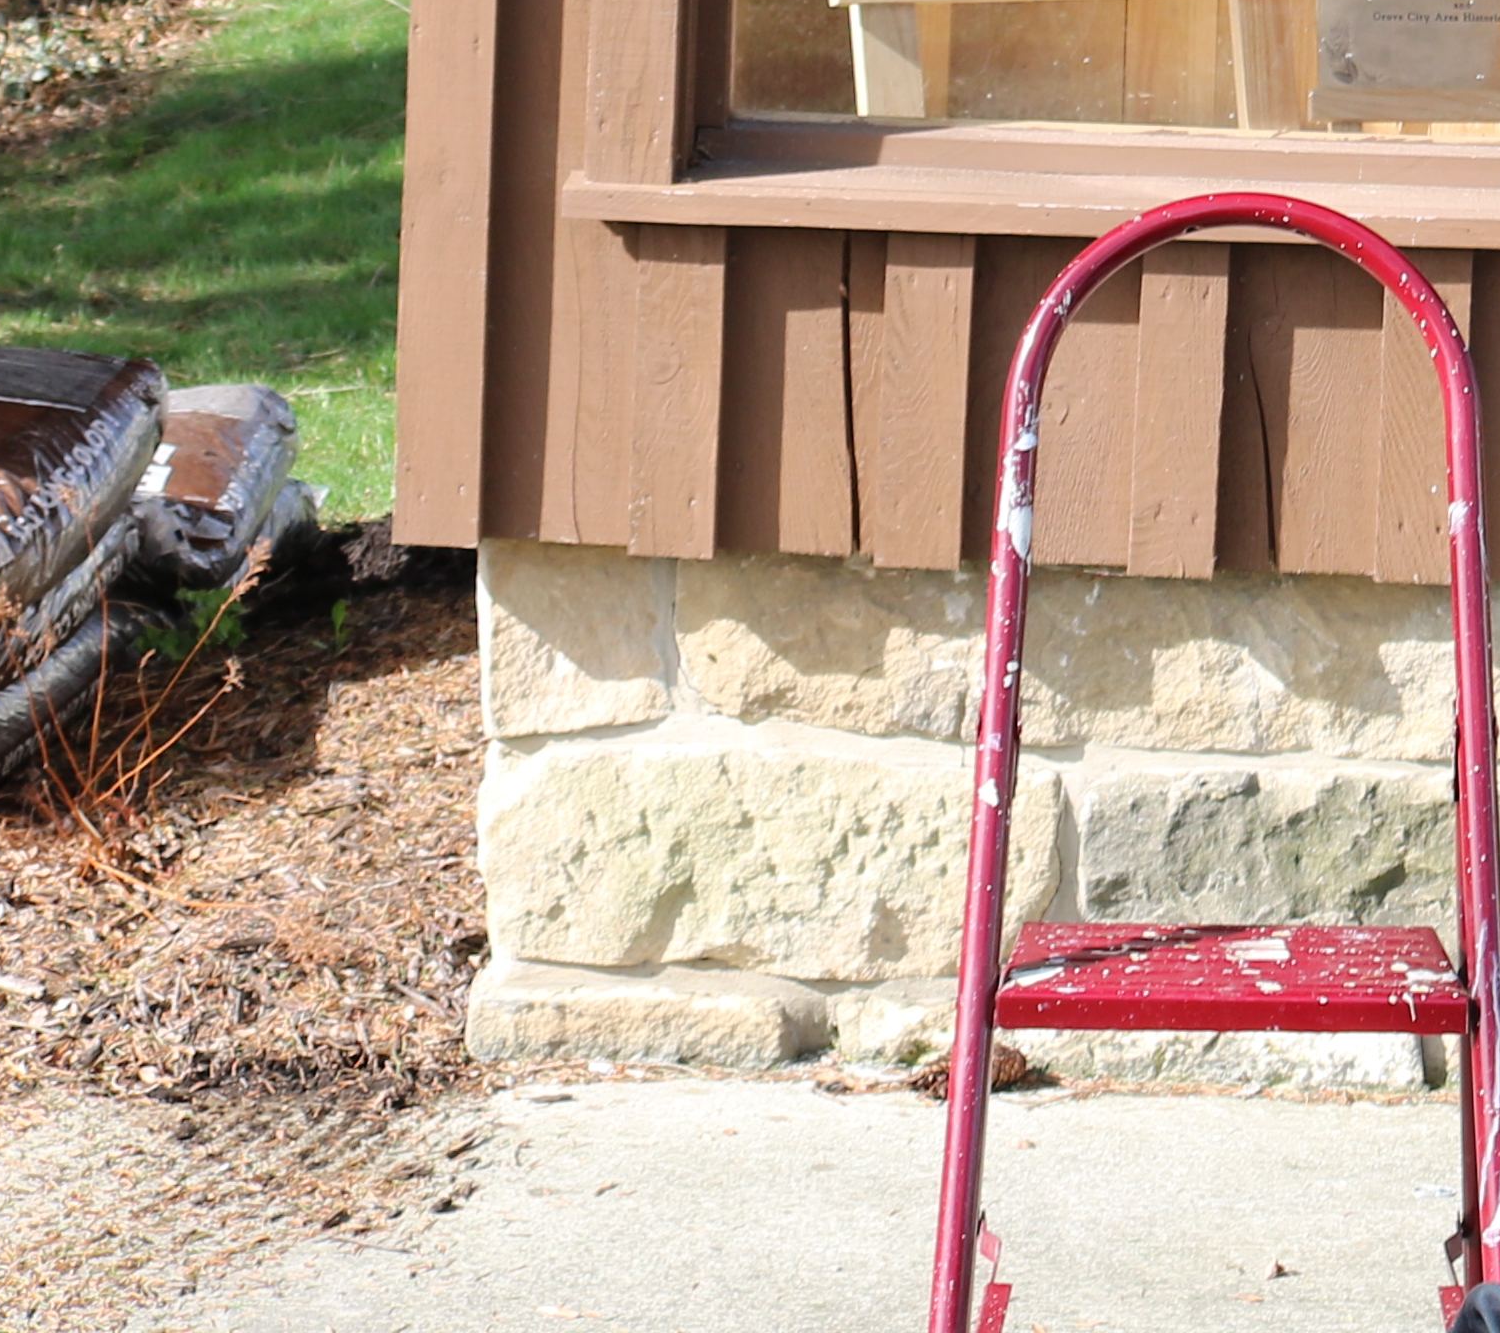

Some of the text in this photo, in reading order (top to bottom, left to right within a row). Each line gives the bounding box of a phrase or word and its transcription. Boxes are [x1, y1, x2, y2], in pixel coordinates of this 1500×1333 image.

[1373, 12, 1403, 21] Grove
[1407, 12, 1430, 24] City
[1434, 13, 1458, 22] Area
